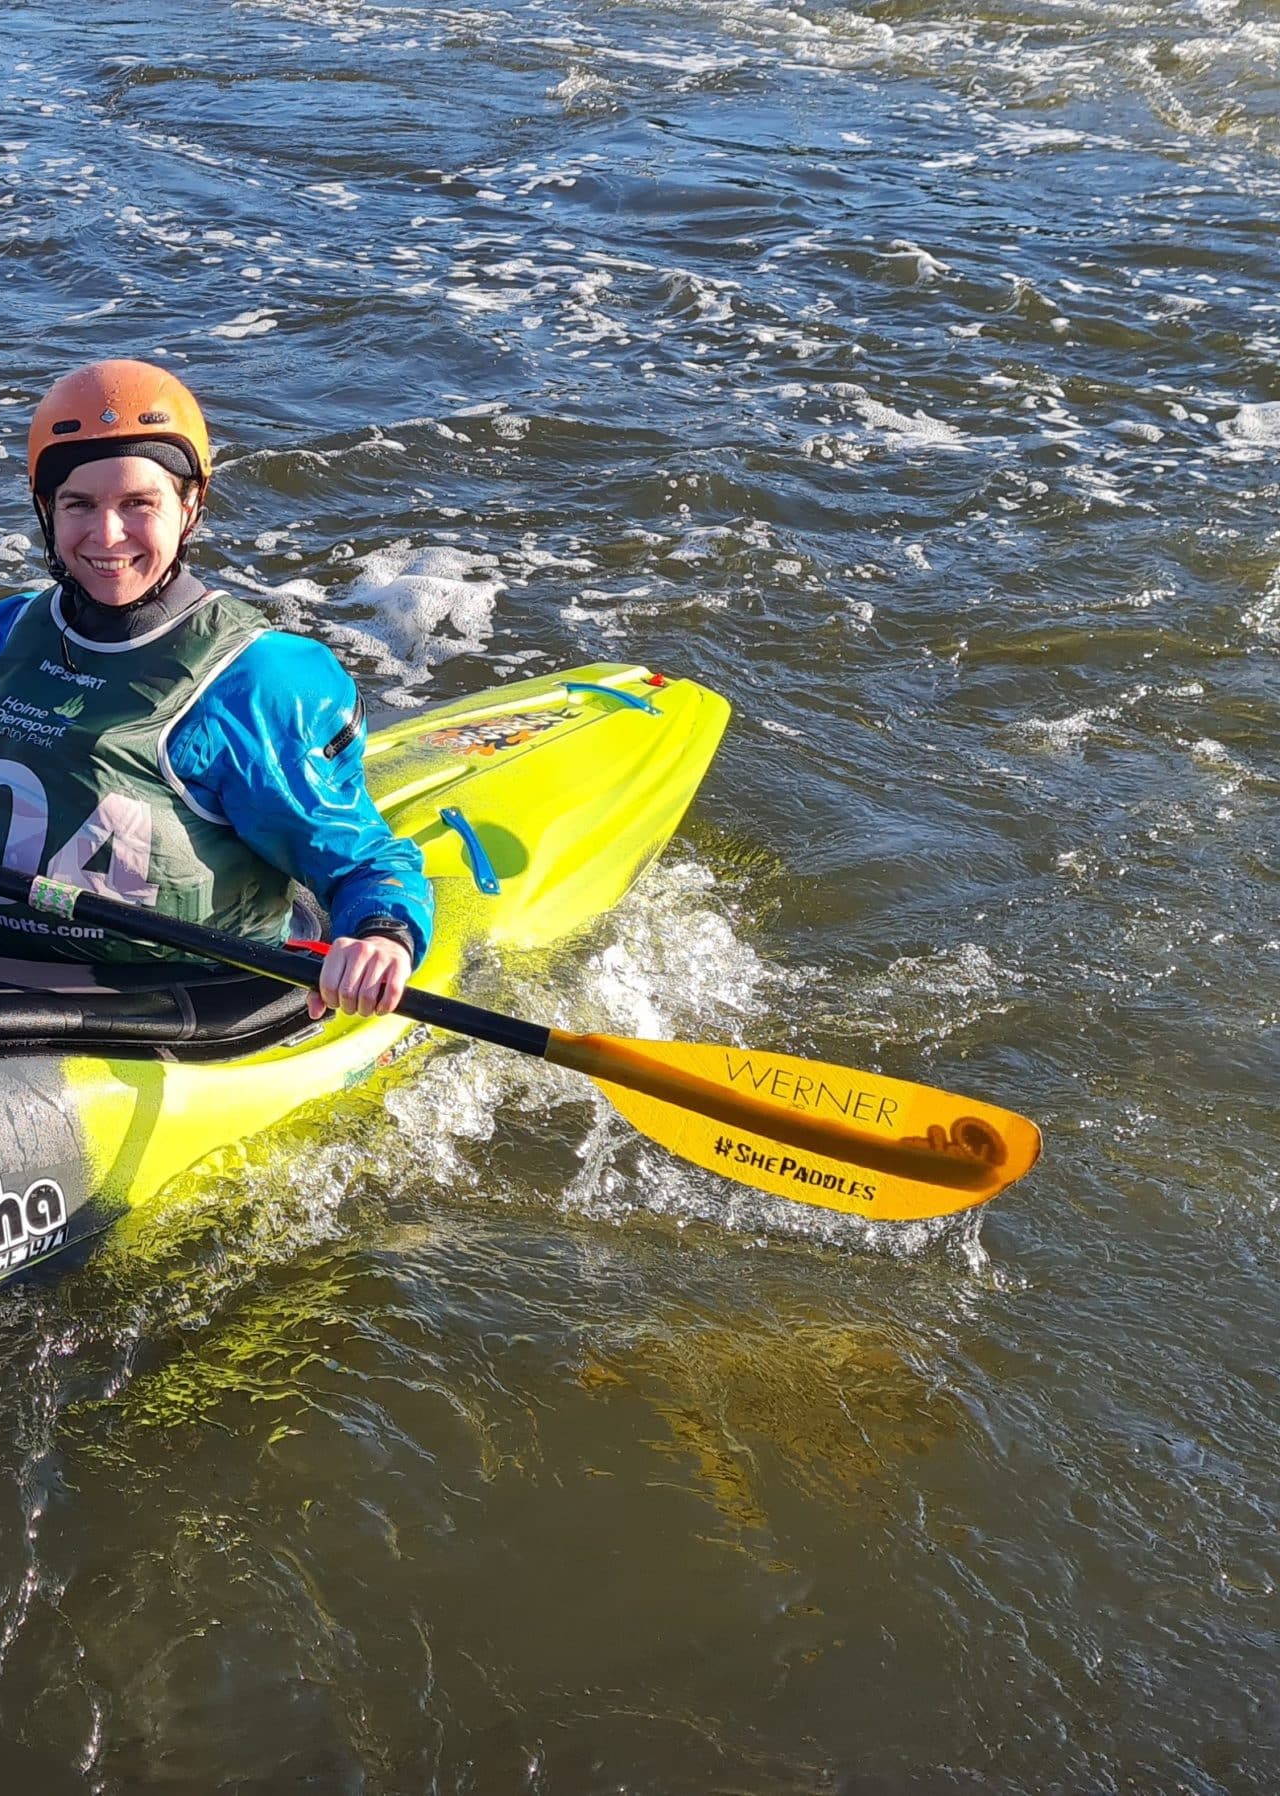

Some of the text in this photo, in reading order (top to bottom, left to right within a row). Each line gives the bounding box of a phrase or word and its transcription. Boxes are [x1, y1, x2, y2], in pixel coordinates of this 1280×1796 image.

[2, 696, 49, 719] Holme
[26, 733, 54, 749] Park
[726, 1053, 898, 1128] WERNER
